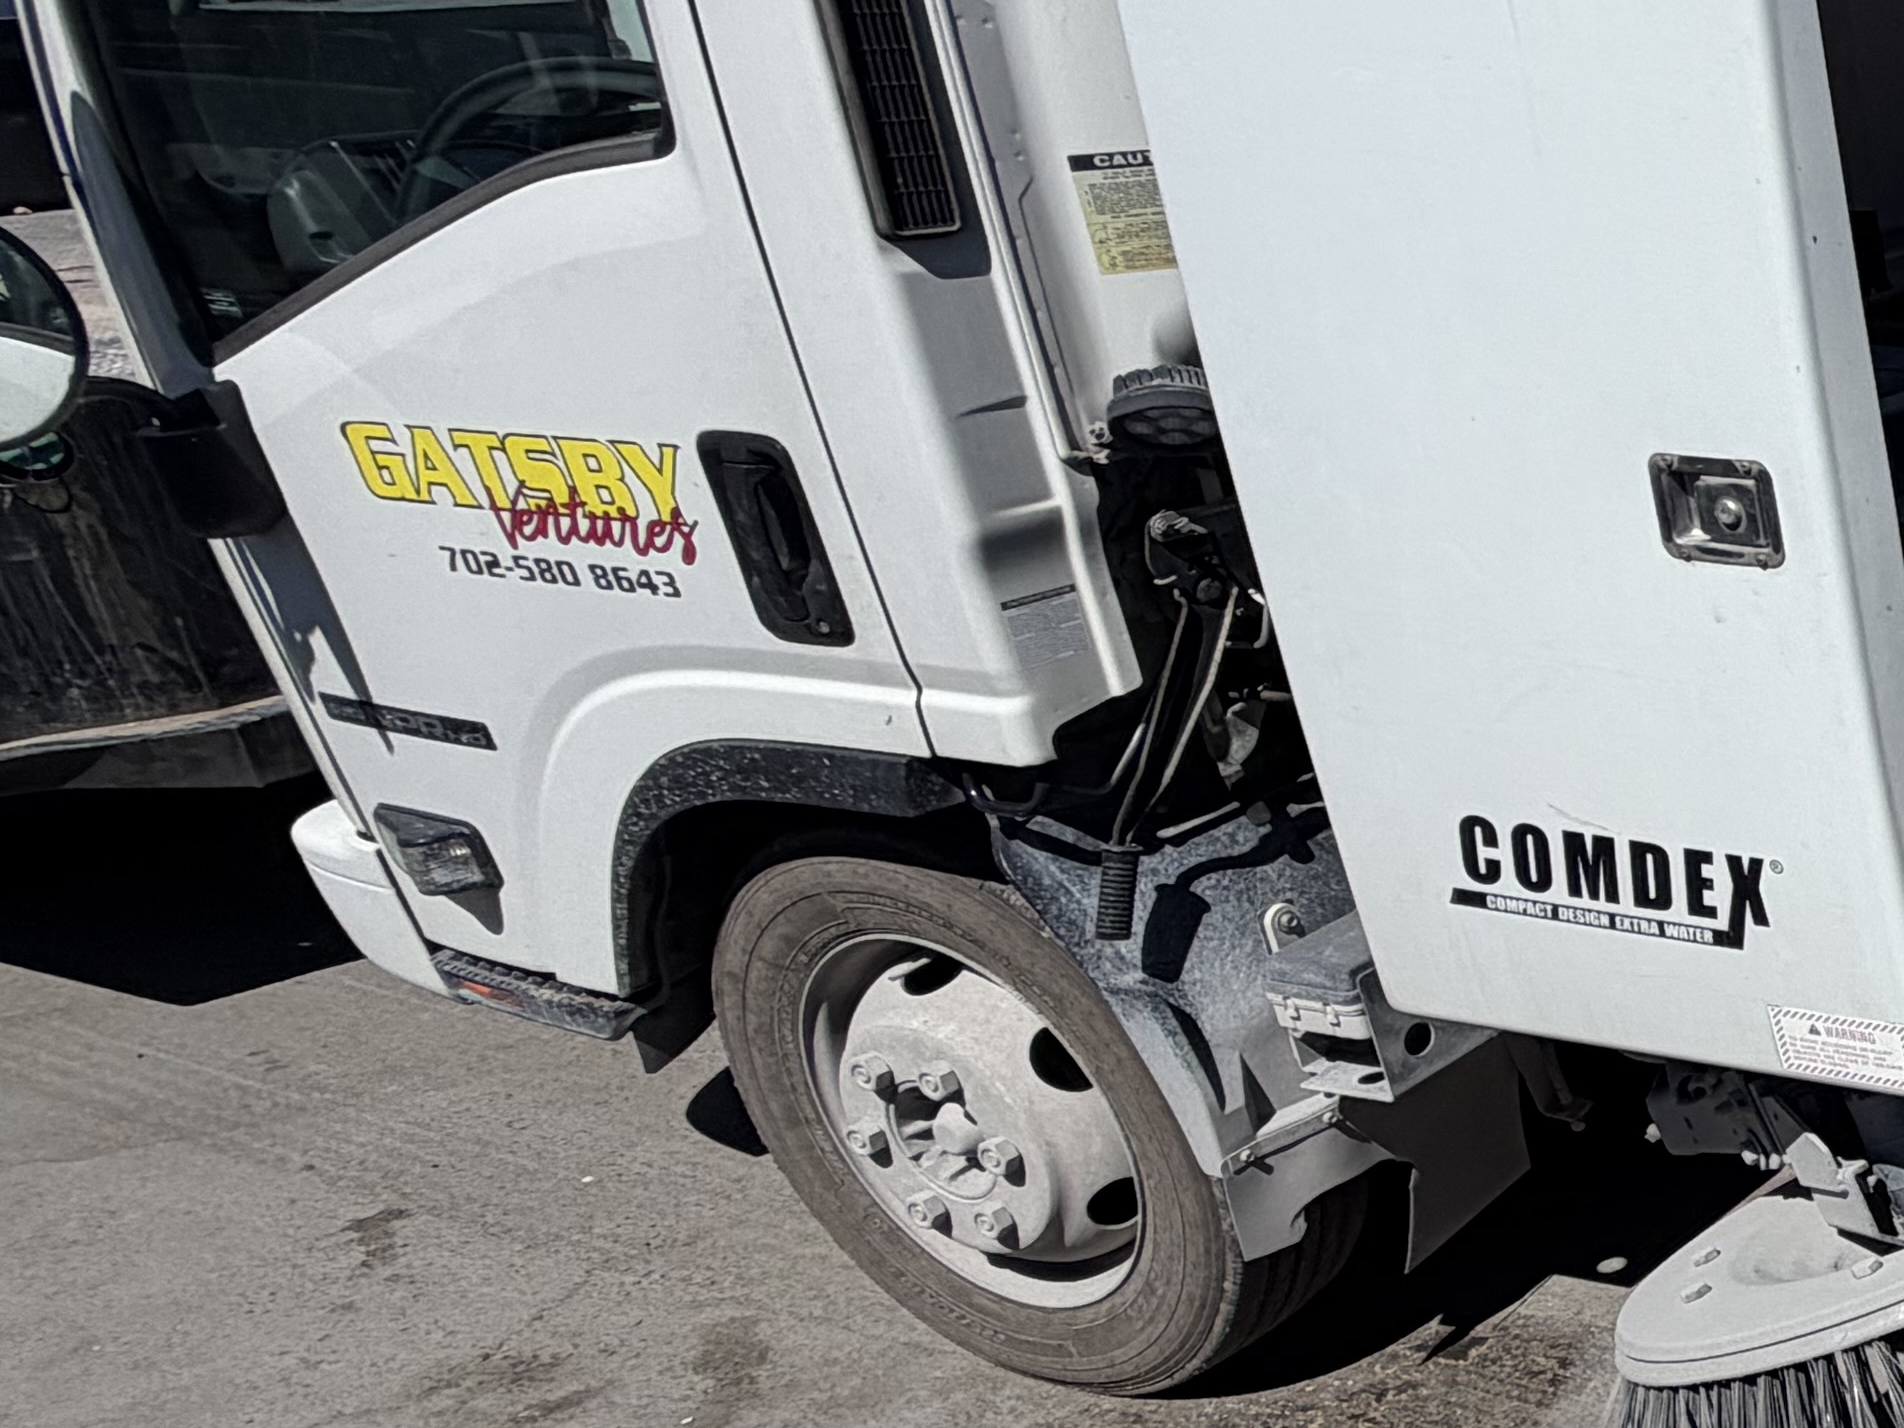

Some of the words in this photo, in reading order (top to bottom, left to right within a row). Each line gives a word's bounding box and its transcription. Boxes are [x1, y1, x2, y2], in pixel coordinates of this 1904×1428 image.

[340, 421, 681, 524] GATSBY
[488, 481, 699, 566] Ventures
[439, 546, 581, 587] 702-580
[592, 563, 682, 599] 8643
[1459, 814, 1770, 932] COMDEX
[1486, 894, 1554, 919] COMPACT
[1558, 906, 1610, 928] DESIGN
[1615, 915, 1659, 935] EXTRA
[1663, 922, 1714, 944] WATER
[1823, 1025, 1877, 1045] WARNING
